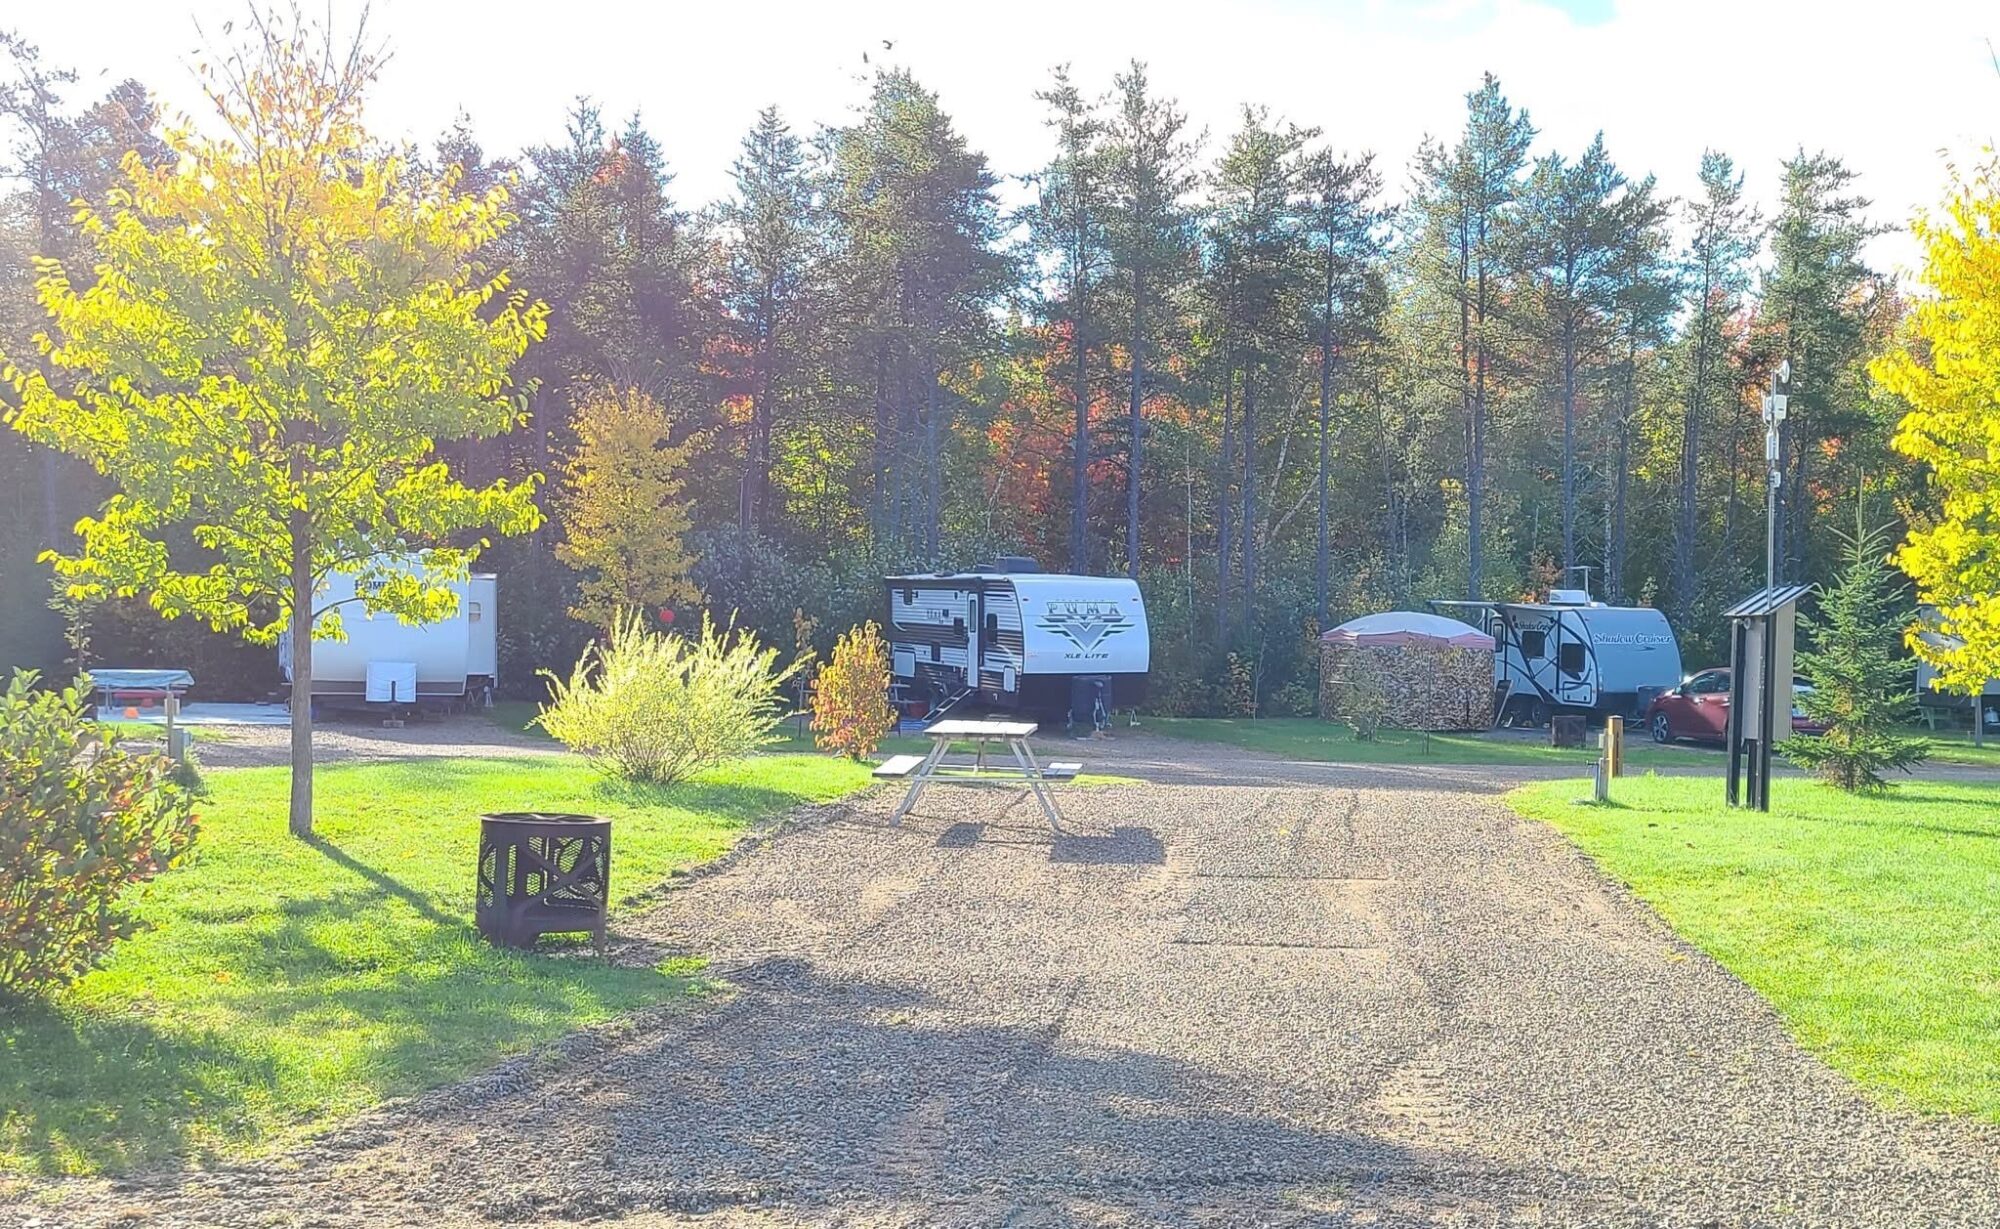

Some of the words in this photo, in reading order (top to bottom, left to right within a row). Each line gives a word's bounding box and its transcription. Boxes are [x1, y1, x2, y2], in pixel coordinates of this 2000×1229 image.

[1047, 602, 1120, 614] PUMA
[1594, 633, 1635, 644] Shadow
[1635, 633, 1672, 645] Cruiser
